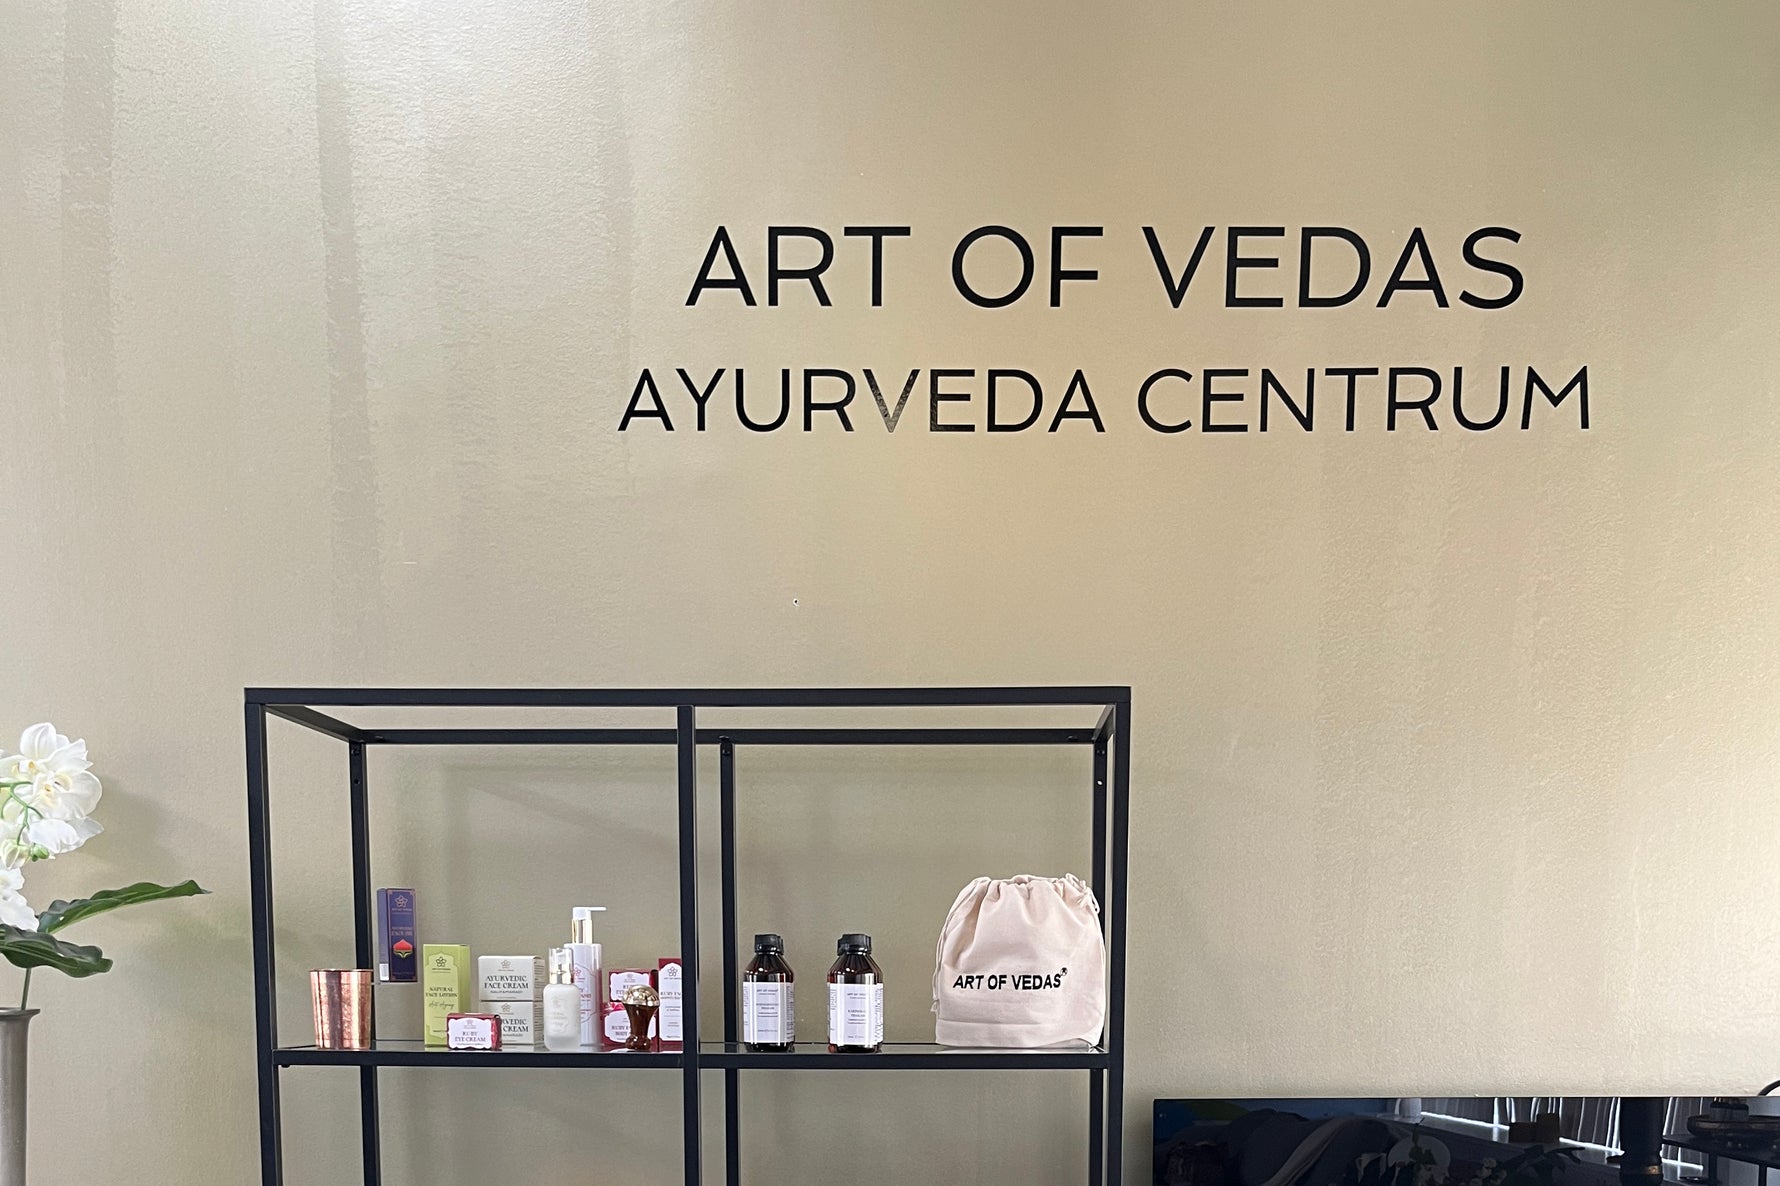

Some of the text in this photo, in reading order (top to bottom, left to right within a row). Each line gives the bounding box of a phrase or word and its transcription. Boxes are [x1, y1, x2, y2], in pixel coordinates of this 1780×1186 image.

[684, 225, 1525, 309] ART OF VEDAS
[617, 365, 1591, 434] AYURVEDA CENTRUM
[953, 974, 984, 989] ART
[987, 974, 1007, 990] OF
